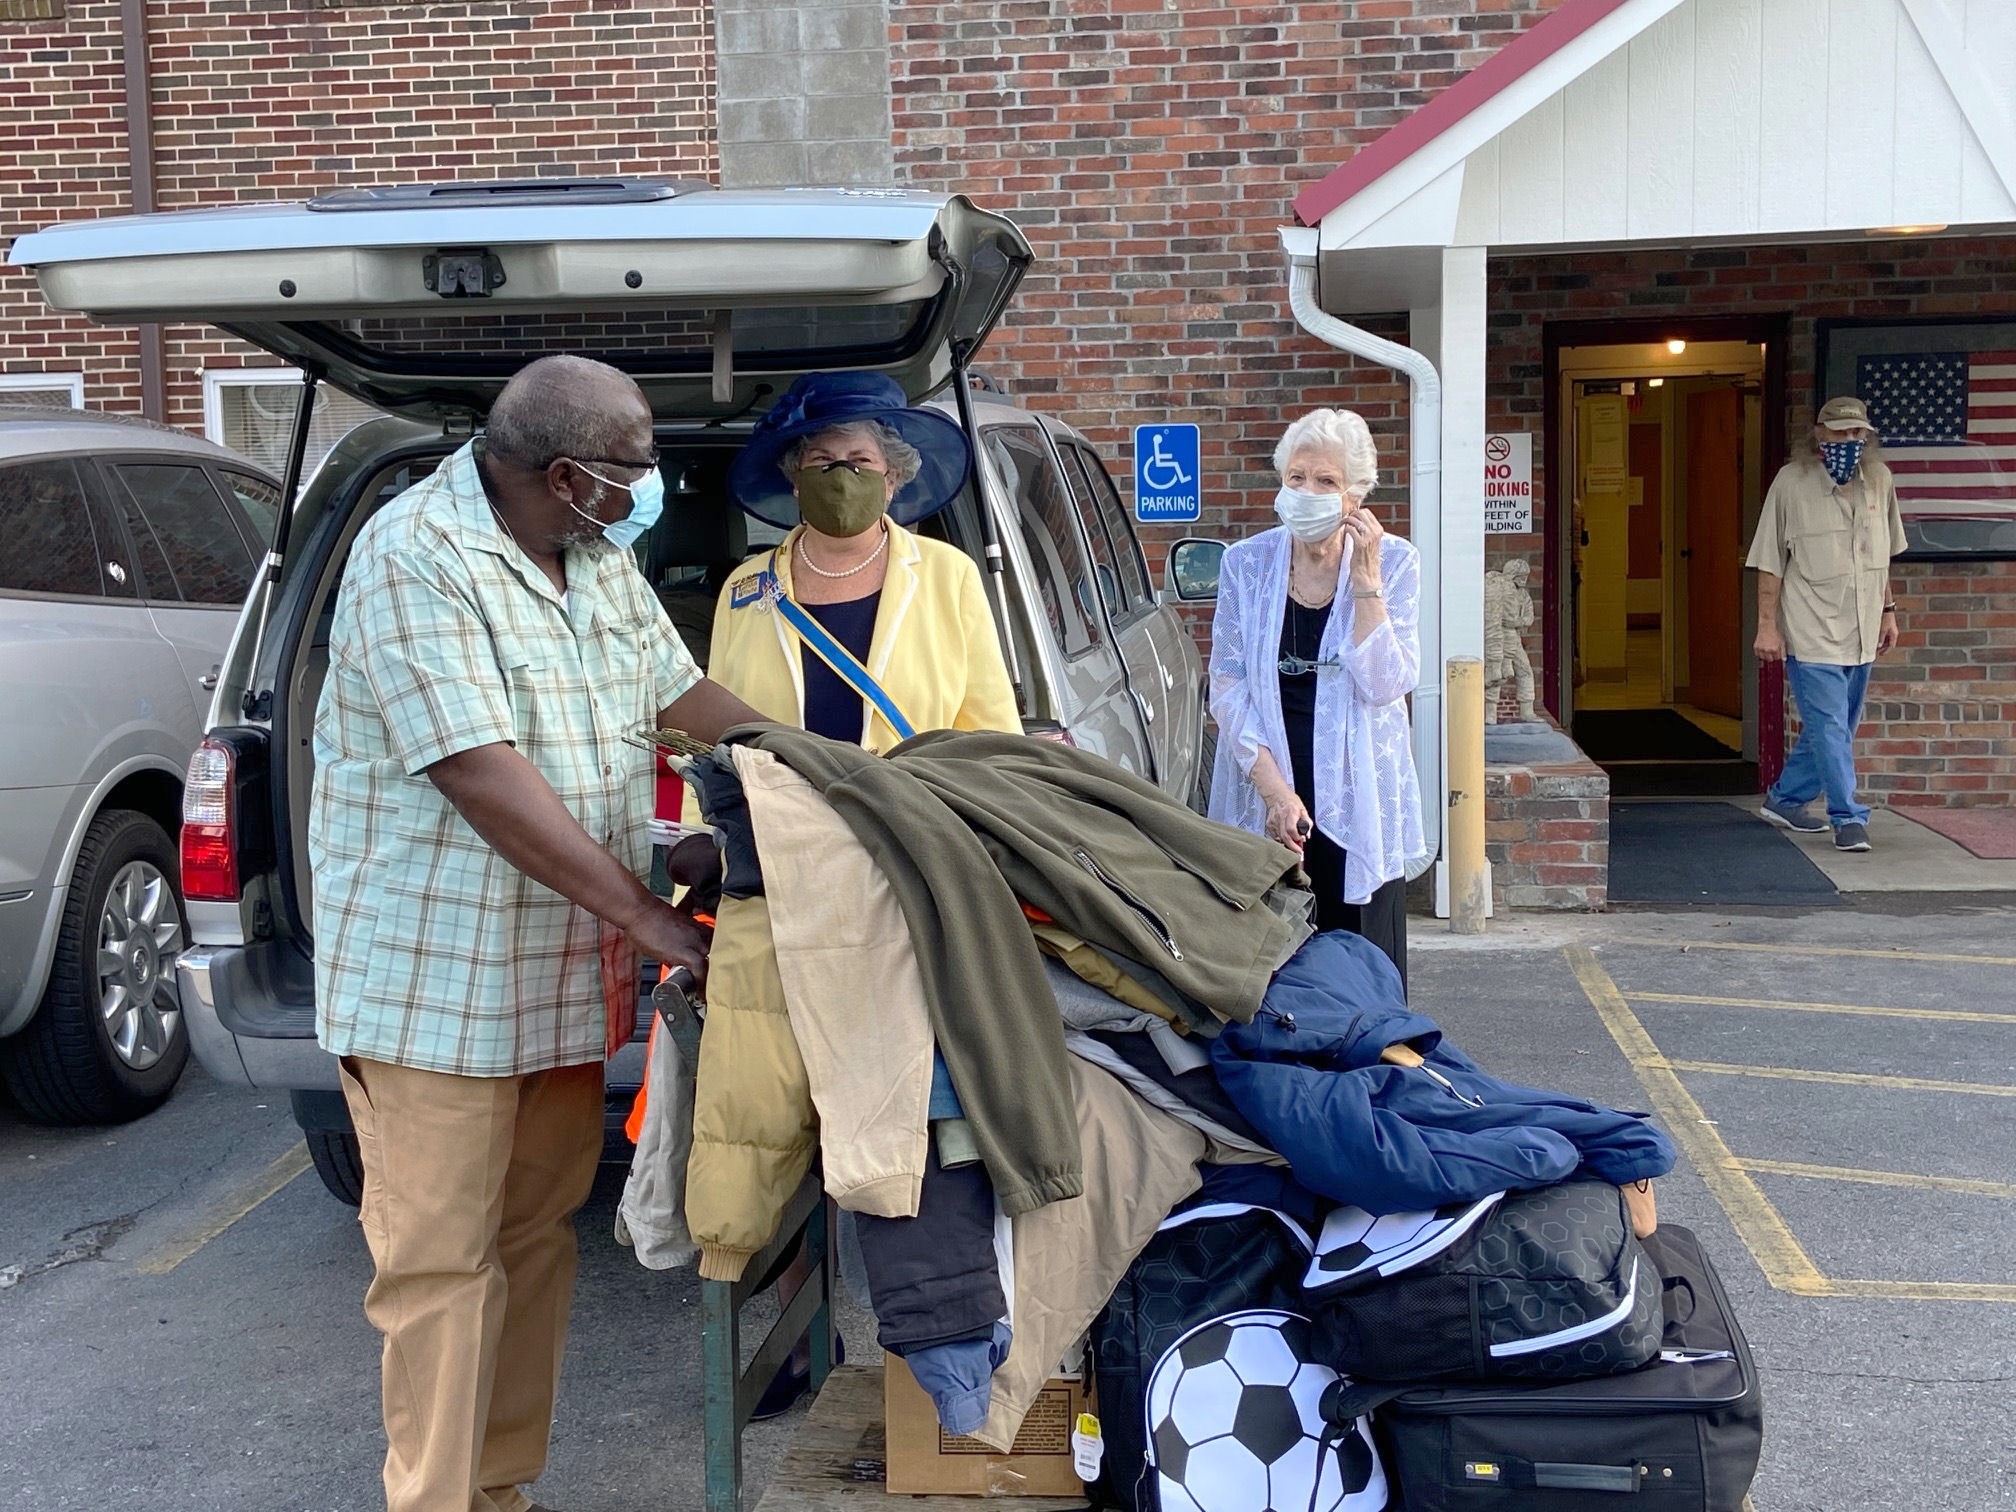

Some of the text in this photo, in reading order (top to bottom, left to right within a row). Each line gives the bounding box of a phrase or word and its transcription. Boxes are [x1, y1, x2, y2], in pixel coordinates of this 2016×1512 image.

[1485, 464, 1511, 479] NO
[1485, 481, 1529, 497] OKING
[1141, 496, 1195, 511] PARKING
[1485, 510, 1529, 520] FEET OF
